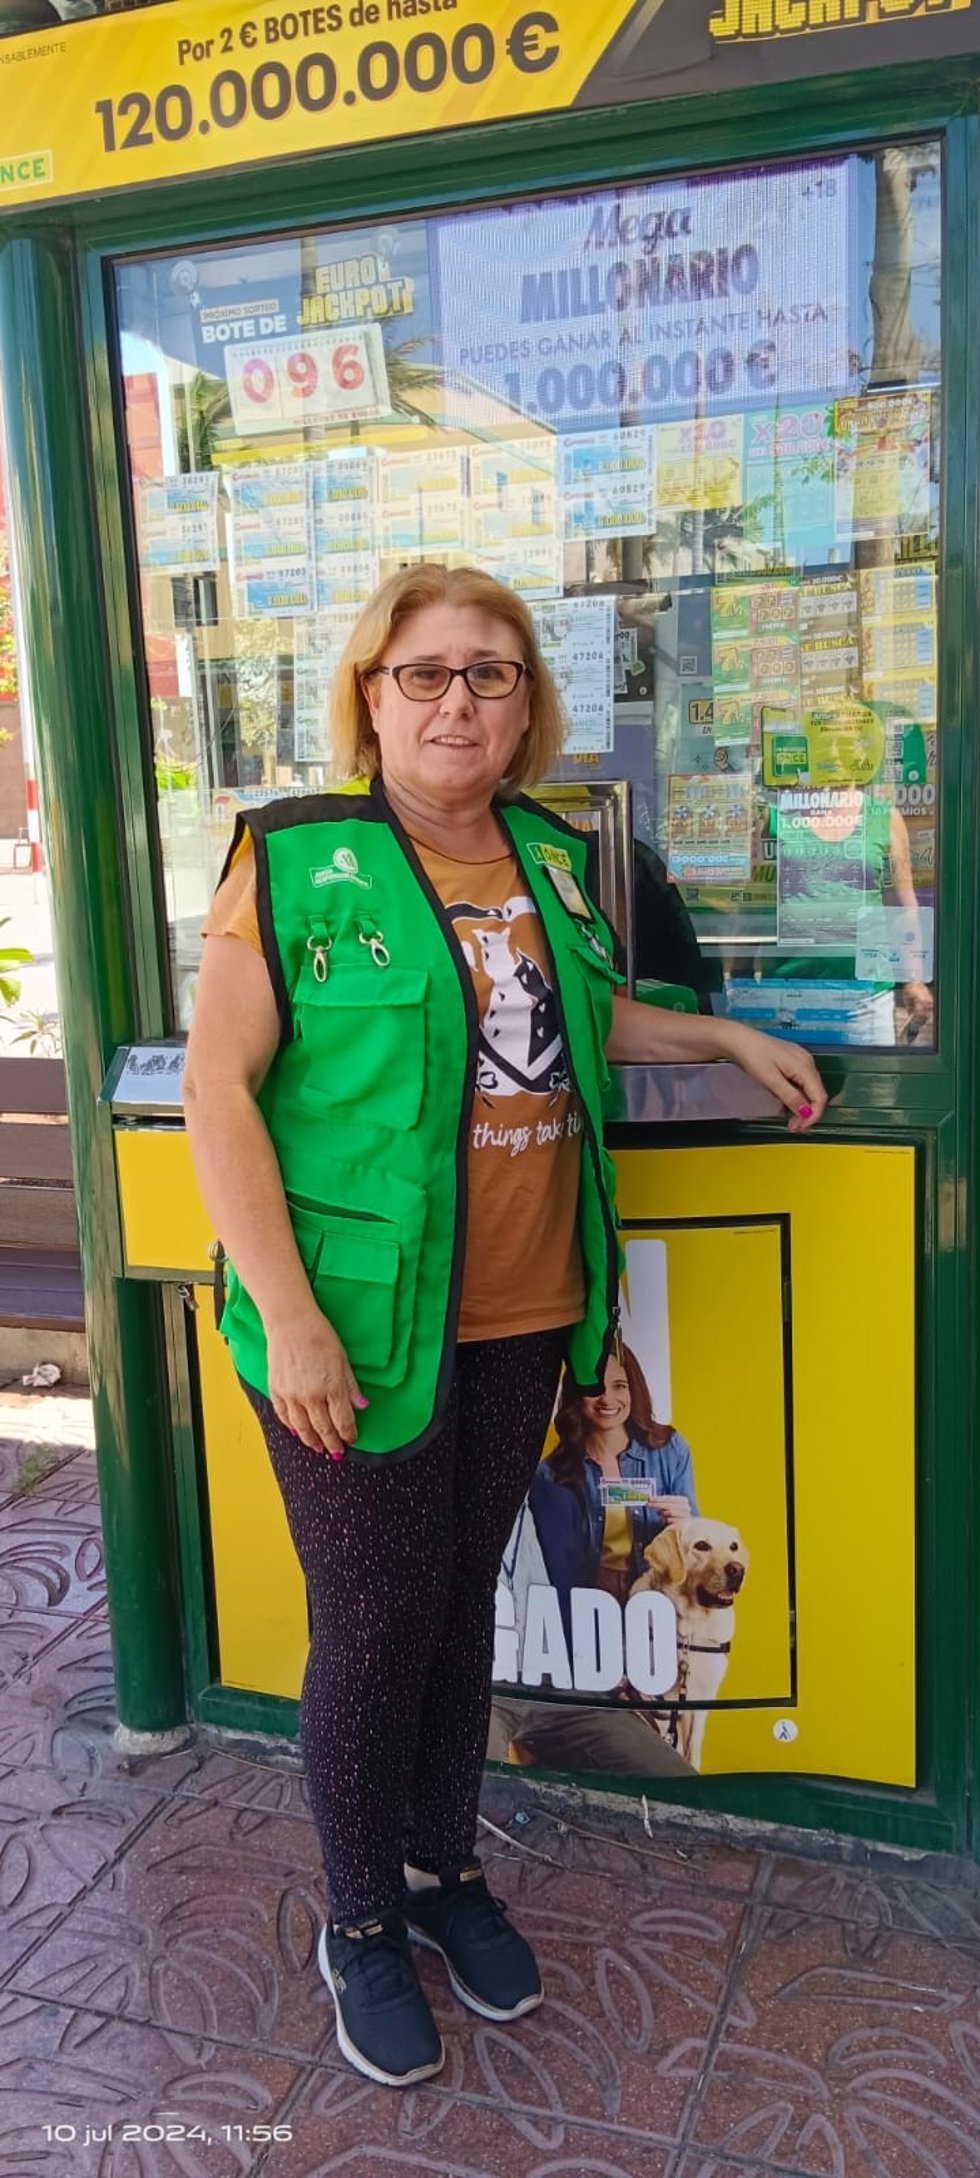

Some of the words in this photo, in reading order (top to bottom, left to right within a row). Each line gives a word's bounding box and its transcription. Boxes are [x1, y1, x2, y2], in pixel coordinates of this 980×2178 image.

[178, 39, 214, 66] Por
[220, 27, 234, 54] 2
[239, 22, 258, 48] €
[264, 12, 343, 45] BOTES
[350, 0, 382, 28] de
[94, 21, 497, 153] 120.000.000
[505, 11, 560, 73] €
[801, 178, 837, 202] +18
[584, 200, 693, 255] Mega
[315, 255, 377, 294] EURO
[520, 243, 761, 325] MILLONARIO
[201, 319, 256, 344] BOTE
[259, 314, 288, 335] DE
[459, 340, 531, 366] PUEDES
[537, 330, 611, 354] GANAR
[618, 327, 643, 347] AL
[649, 312, 752, 342] INSTANTE
[757, 301, 830, 330] HASTA
[241, 343, 366, 404] 096
[503, 346, 736, 414] 1.000.000
[746, 338, 779, 391] €
[779, 790, 864, 810] MILLONARIO
[544, 847, 570, 868] ONCE
[472, 1121, 533, 1157] things
[536, 1118, 564, 1146] tak
